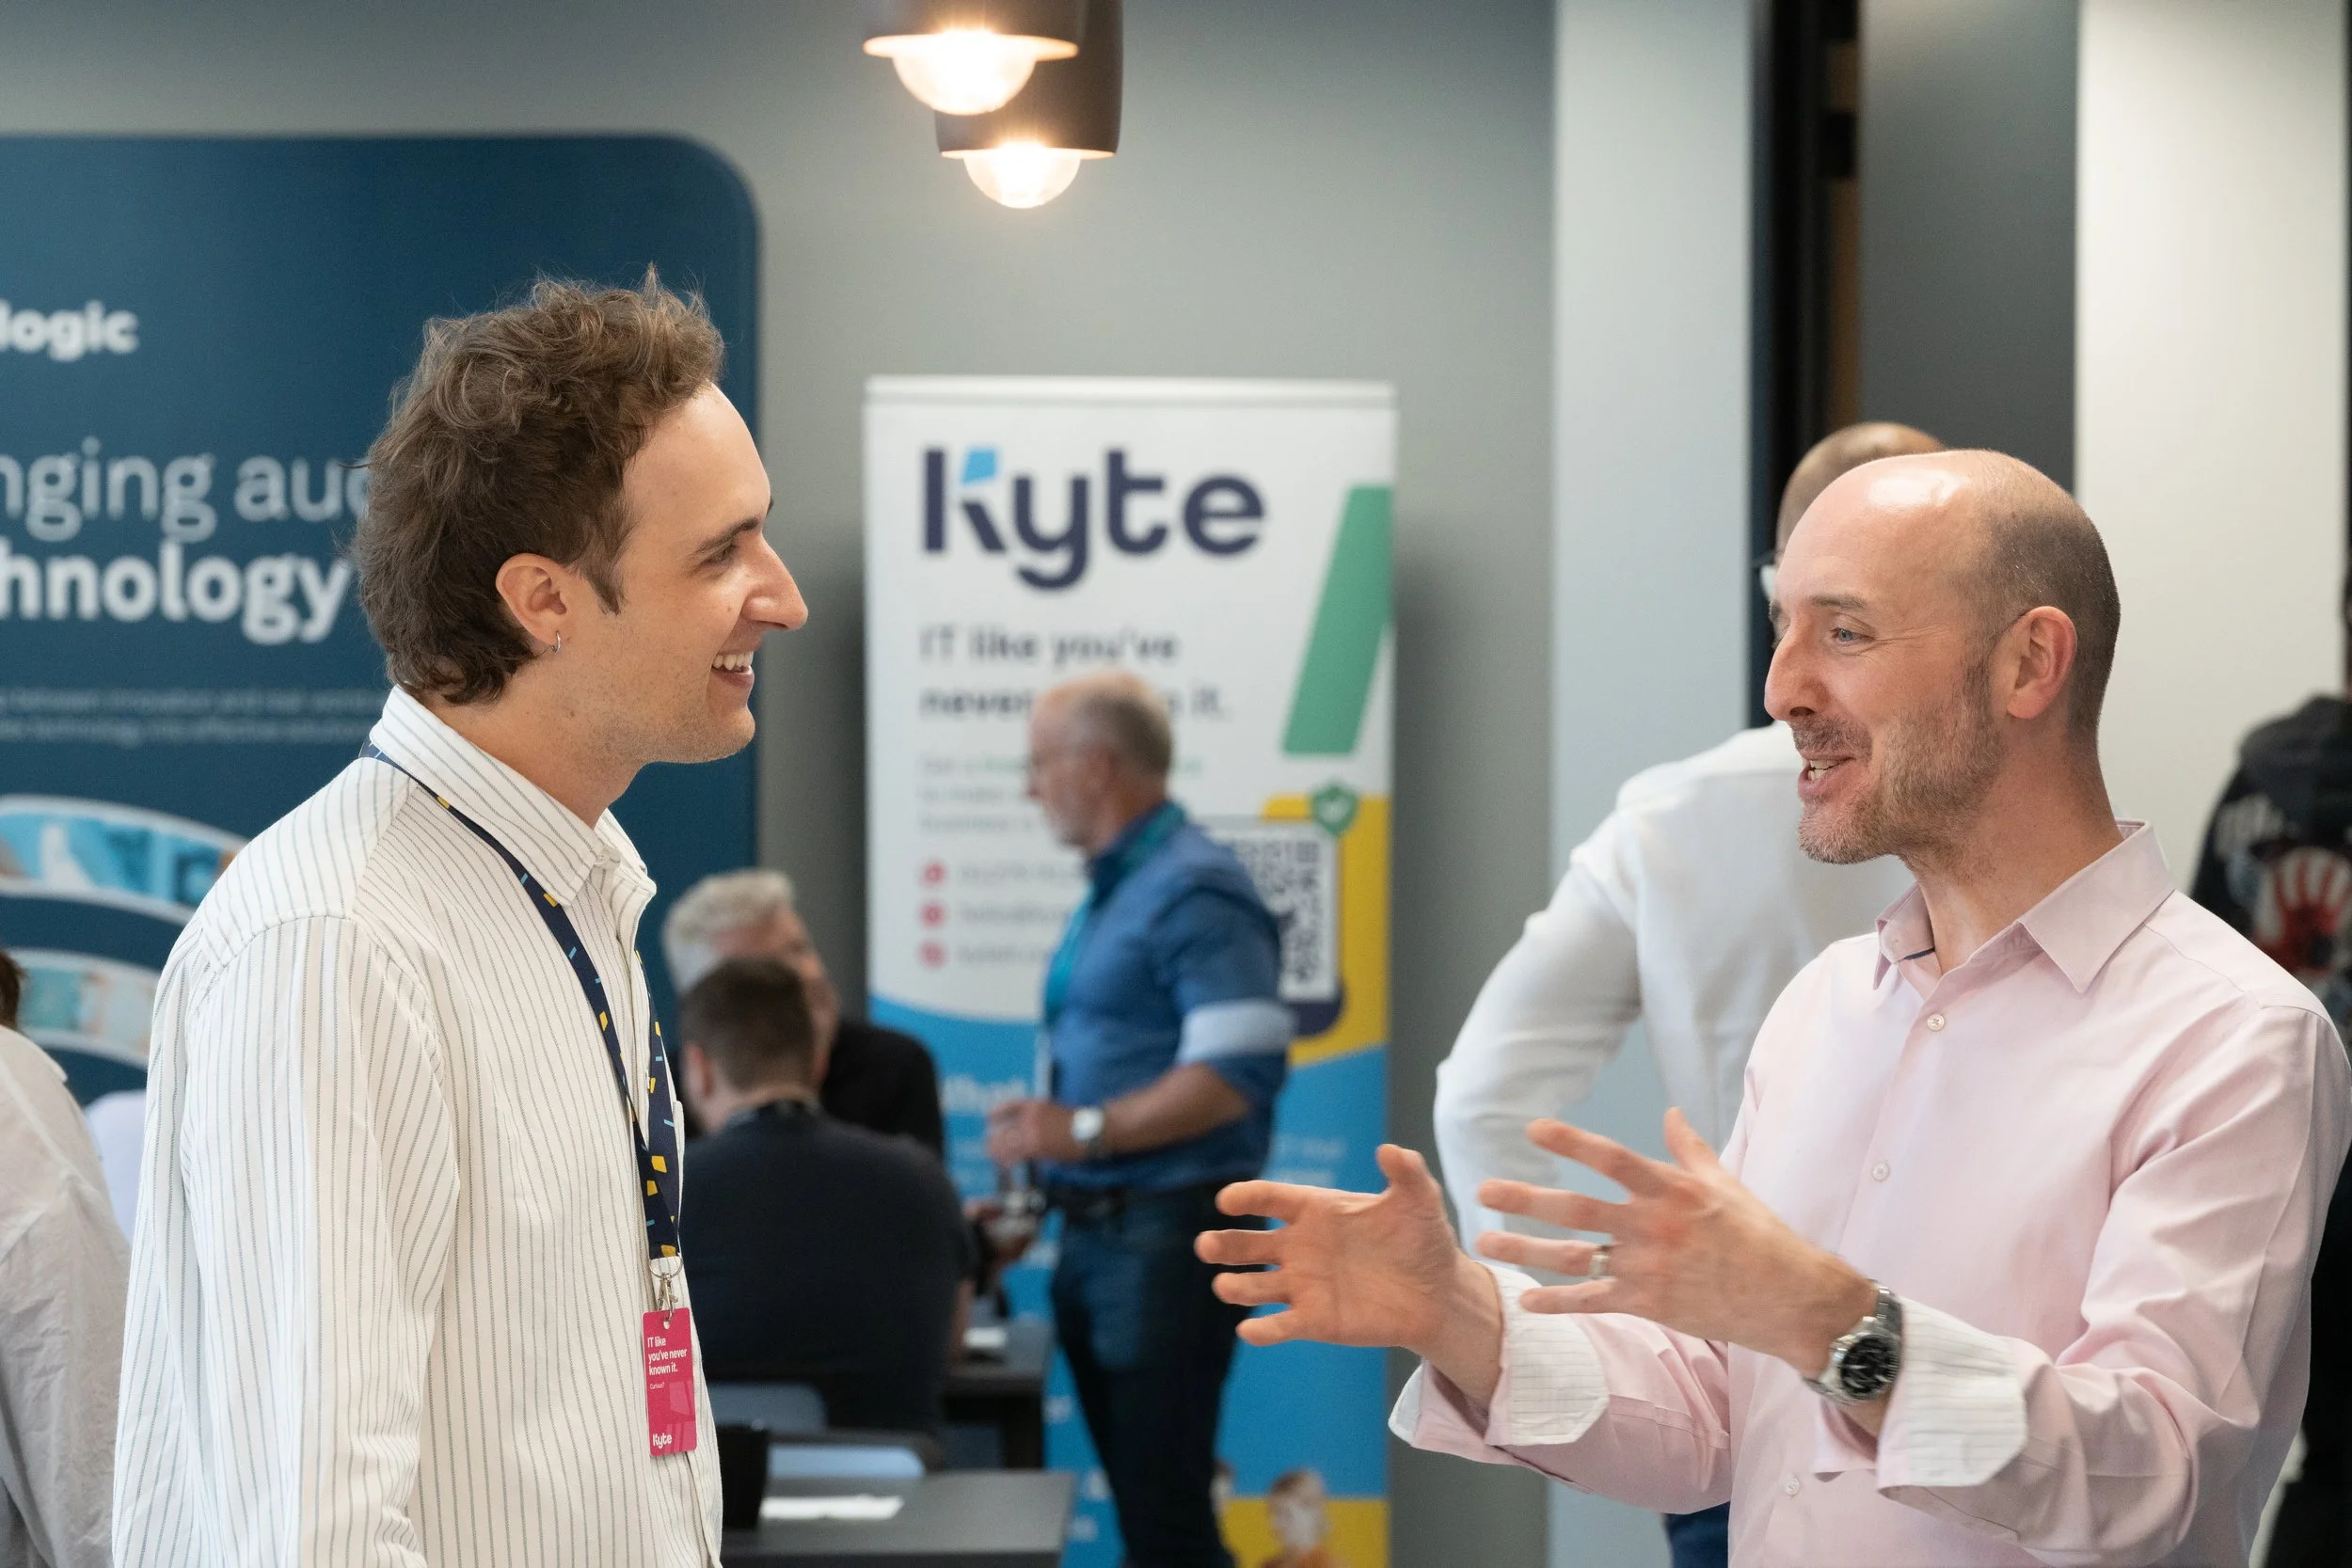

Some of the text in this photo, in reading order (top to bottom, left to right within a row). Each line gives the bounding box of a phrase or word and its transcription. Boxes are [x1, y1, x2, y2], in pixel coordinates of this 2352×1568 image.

[923, 447, 1266, 593] Kyte
[971, 625, 1038, 659] like
[647, 1336, 666, 1348] IT like
[648, 1348, 687, 1364] you've never
[649, 1364, 671, 1376] known
[652, 1433, 673, 1449] Kyte
